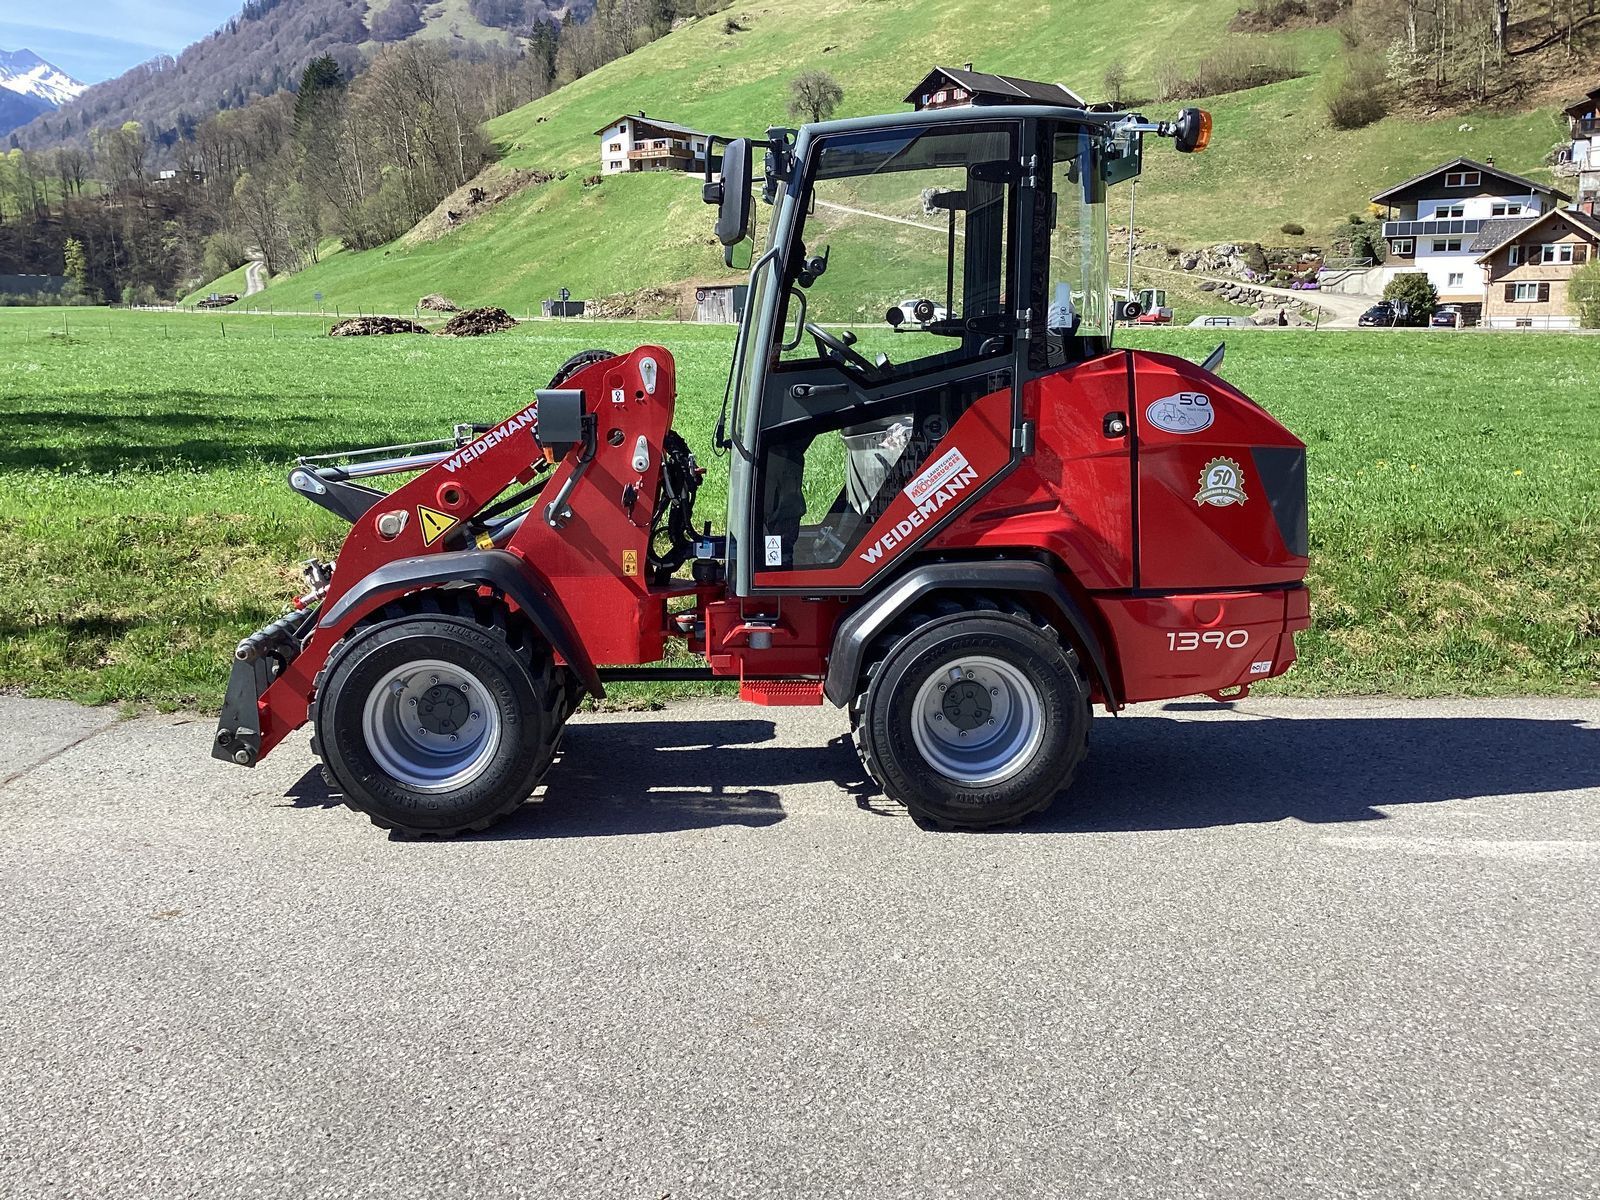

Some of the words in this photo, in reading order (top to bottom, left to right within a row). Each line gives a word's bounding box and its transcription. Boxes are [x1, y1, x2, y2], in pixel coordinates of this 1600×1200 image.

[1179, 394, 1209, 406] 50
[442, 403, 538, 472] WEIDEMANN
[927, 453, 957, 479] LANDTECHNIK
[1212, 469, 1232, 486] 50
[860, 466, 978, 564] WEIDEMANN
[1167, 629, 1249, 651] 1390
